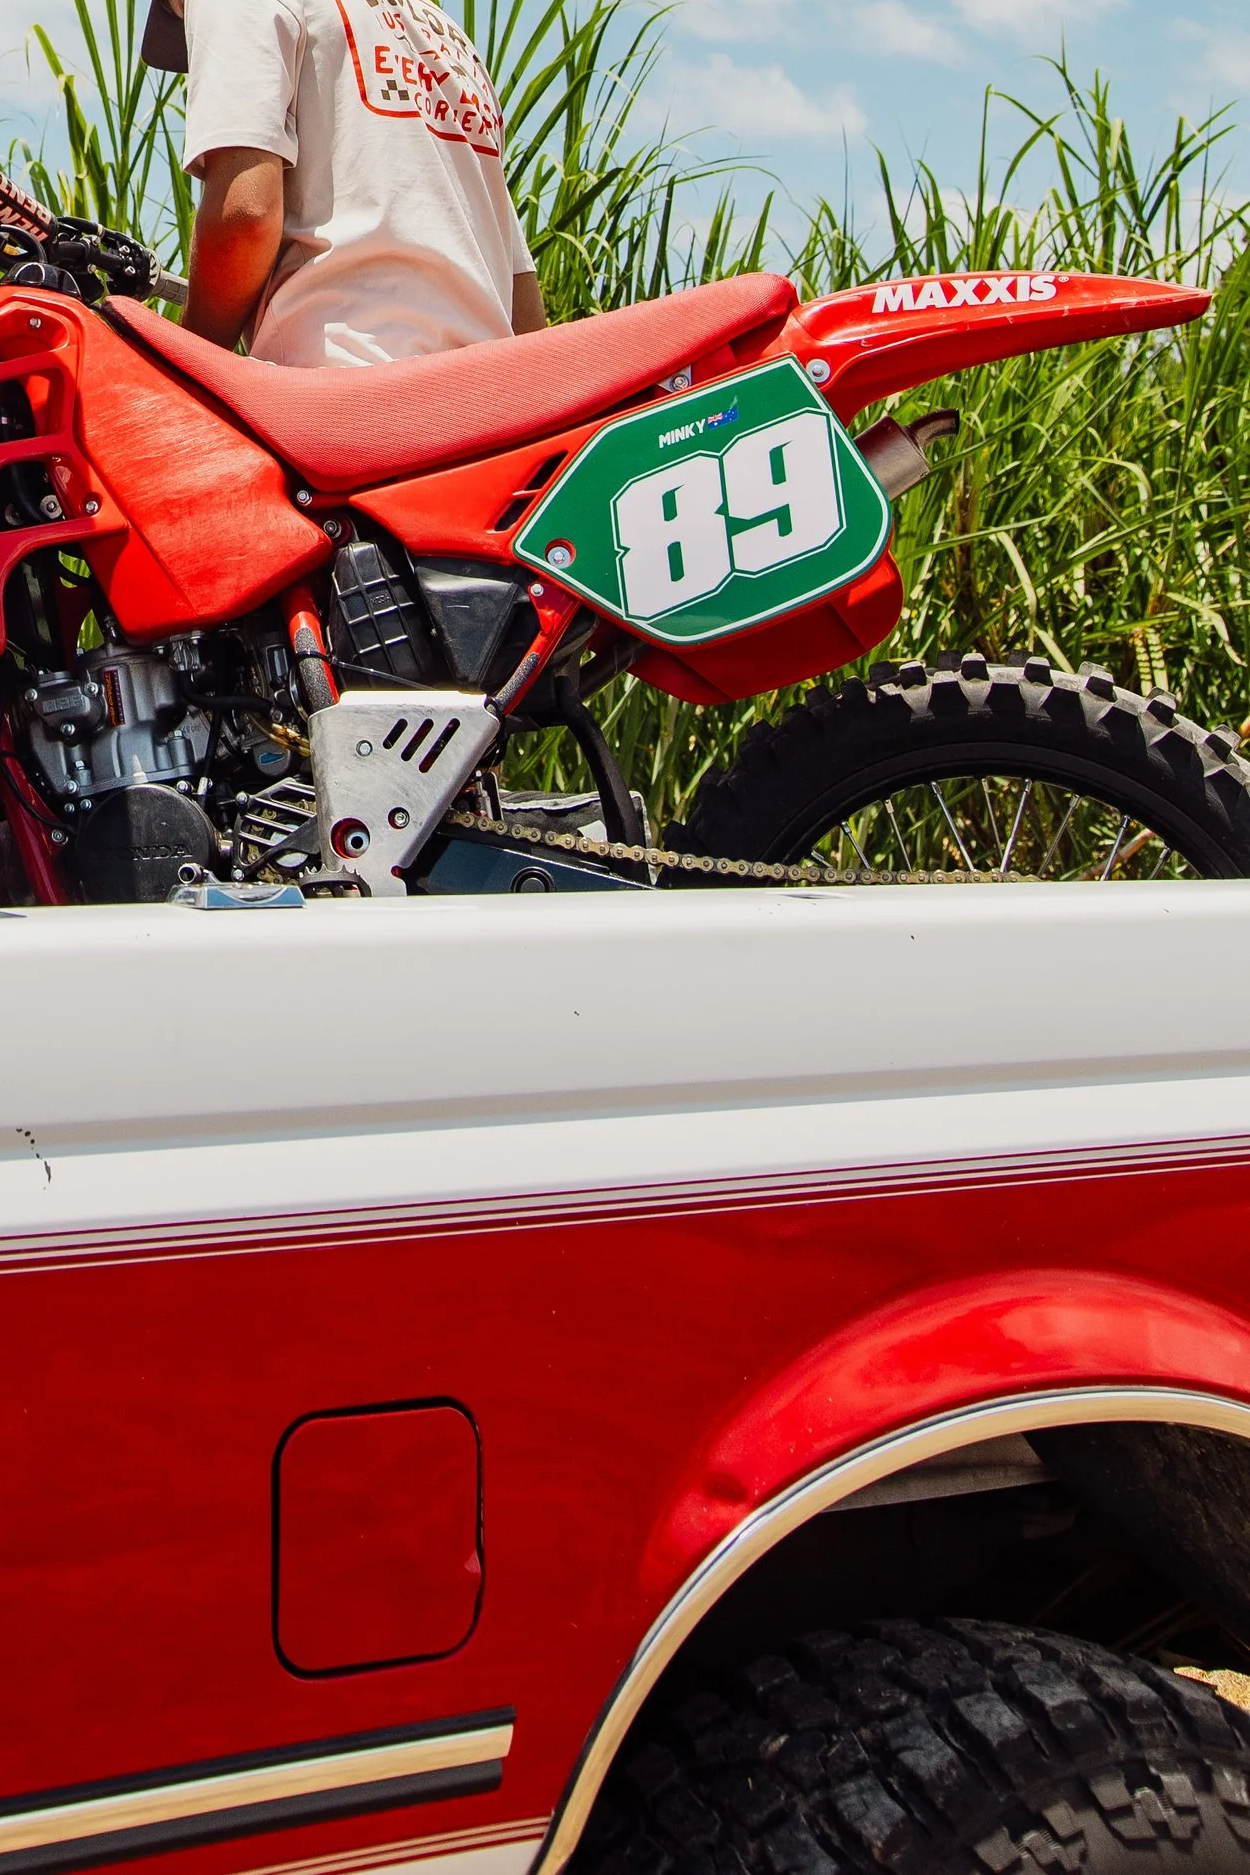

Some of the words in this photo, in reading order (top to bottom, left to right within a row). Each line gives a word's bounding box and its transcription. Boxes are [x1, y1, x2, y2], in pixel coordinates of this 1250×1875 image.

[872, 275, 1056, 313] MAXXIS
[658, 418, 706, 449] MINKY
[614, 415, 846, 619] 89
